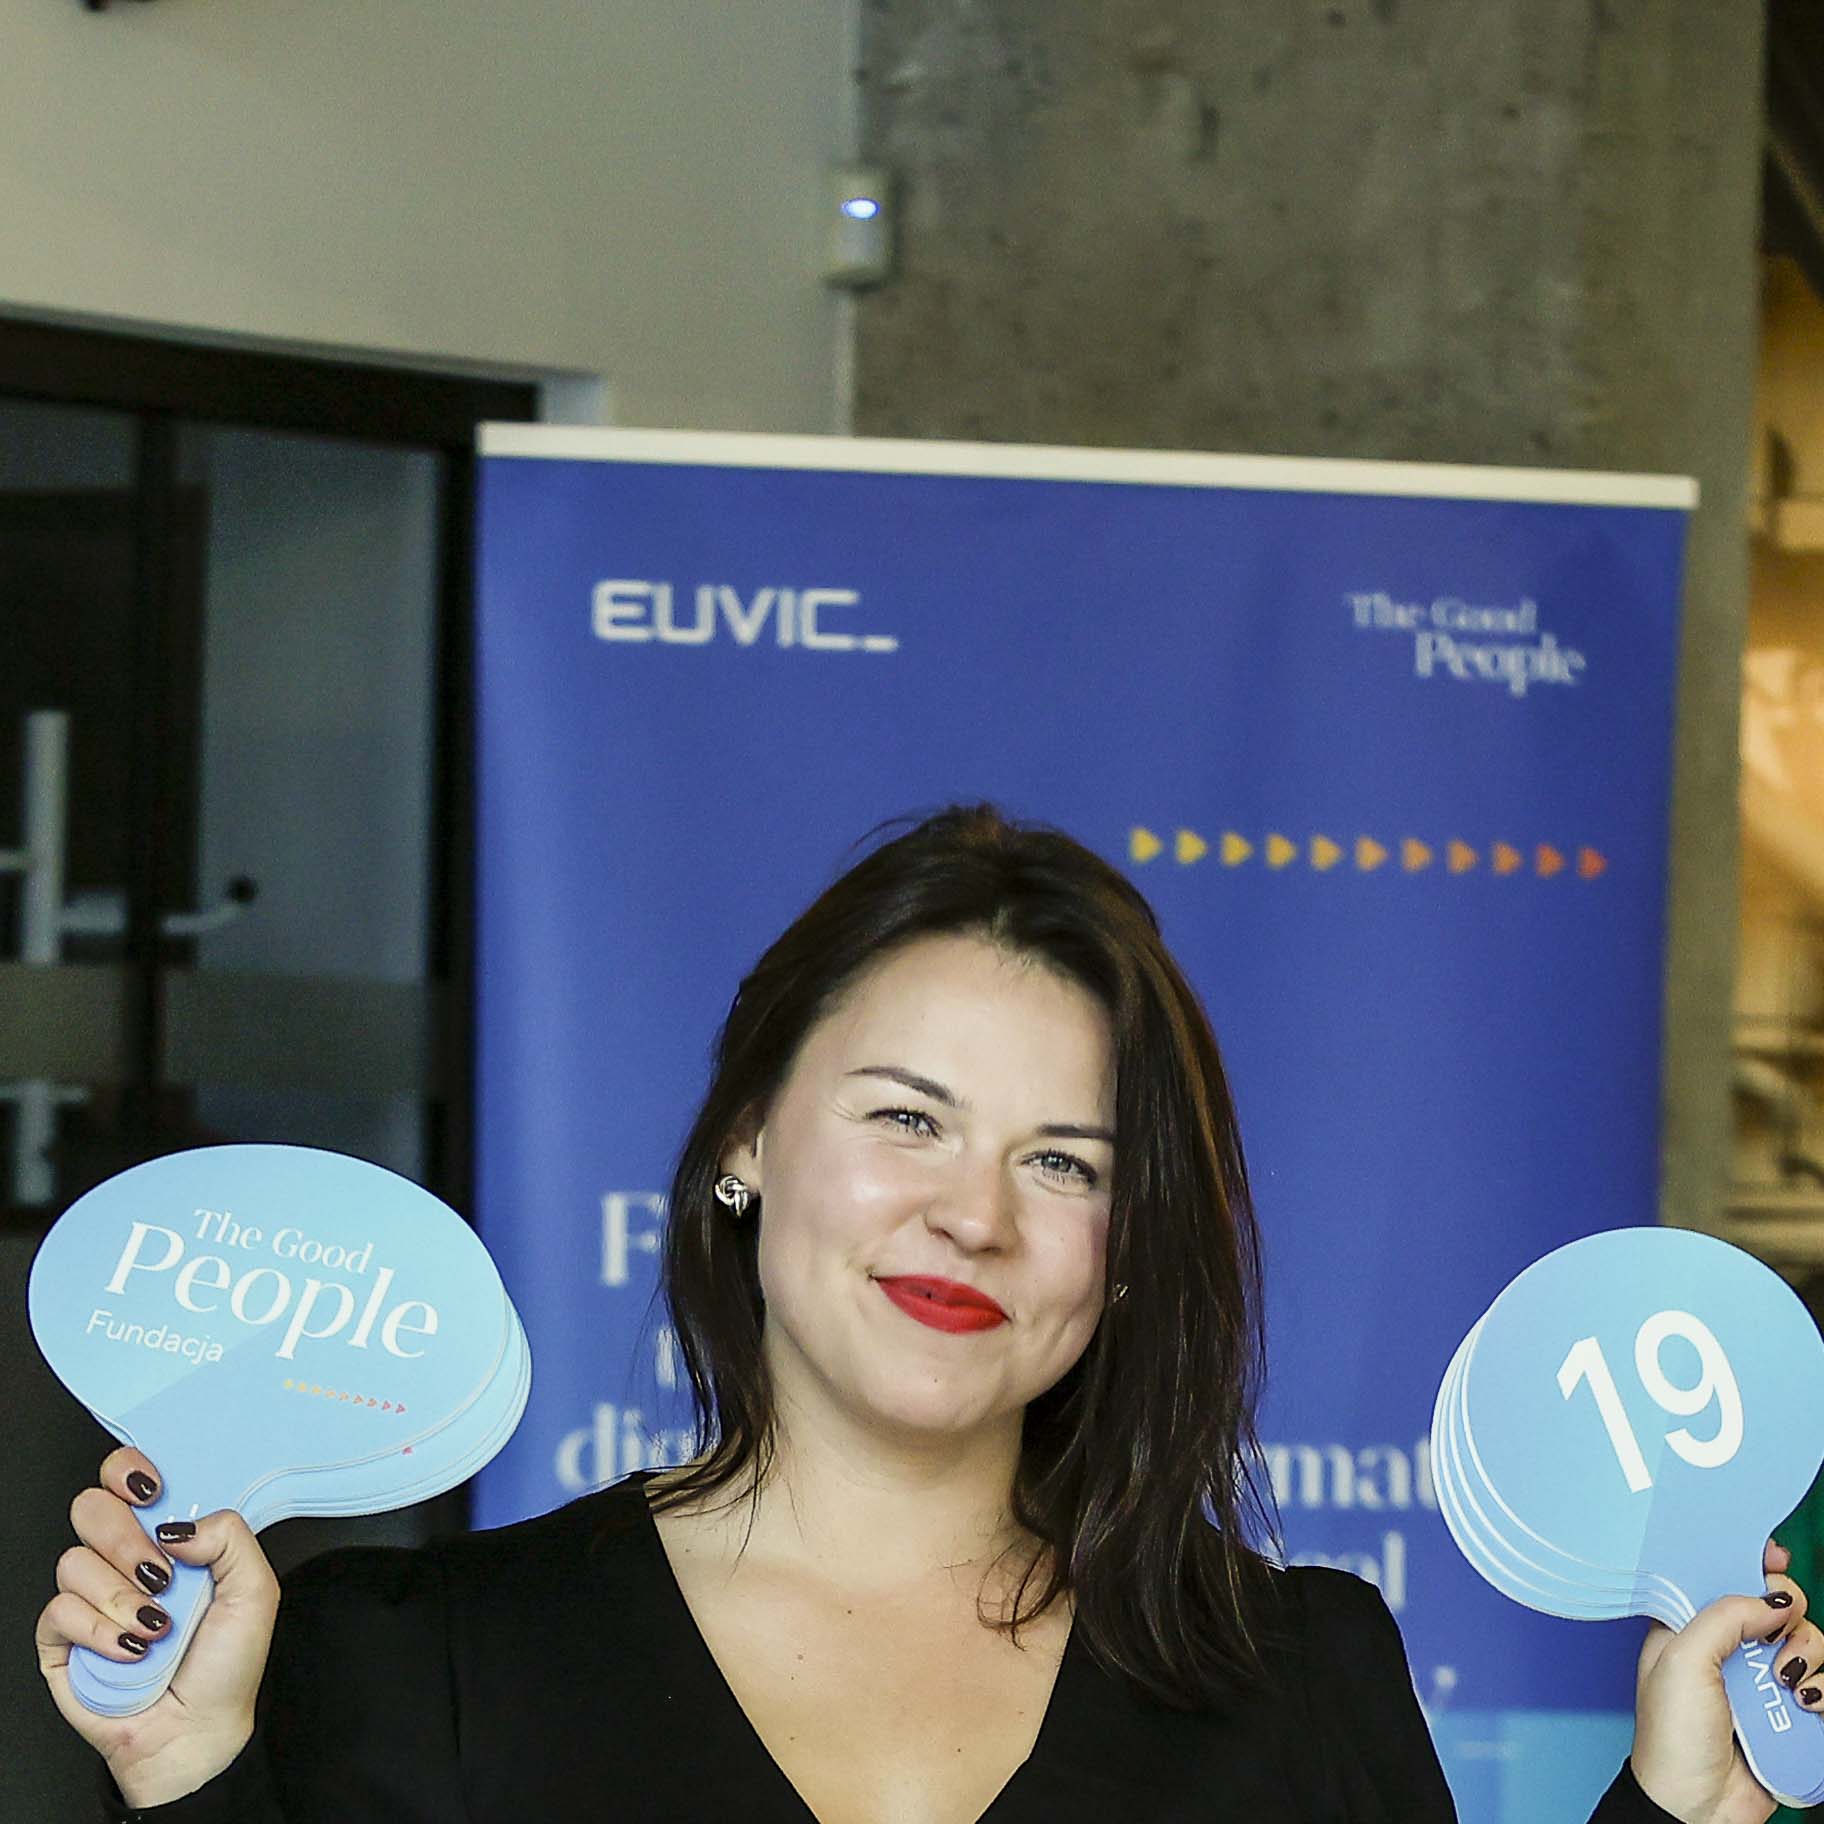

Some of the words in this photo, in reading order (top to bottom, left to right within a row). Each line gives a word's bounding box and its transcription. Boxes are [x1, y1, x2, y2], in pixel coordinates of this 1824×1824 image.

[1414, 632, 1587, 697] People
[192, 1208, 263, 1251] The
[271, 1227, 374, 1275] Good
[103, 1221, 440, 1361] People
[86, 1309, 226, 1365] Fundacja
[1556, 1309, 1745, 1494] 19
